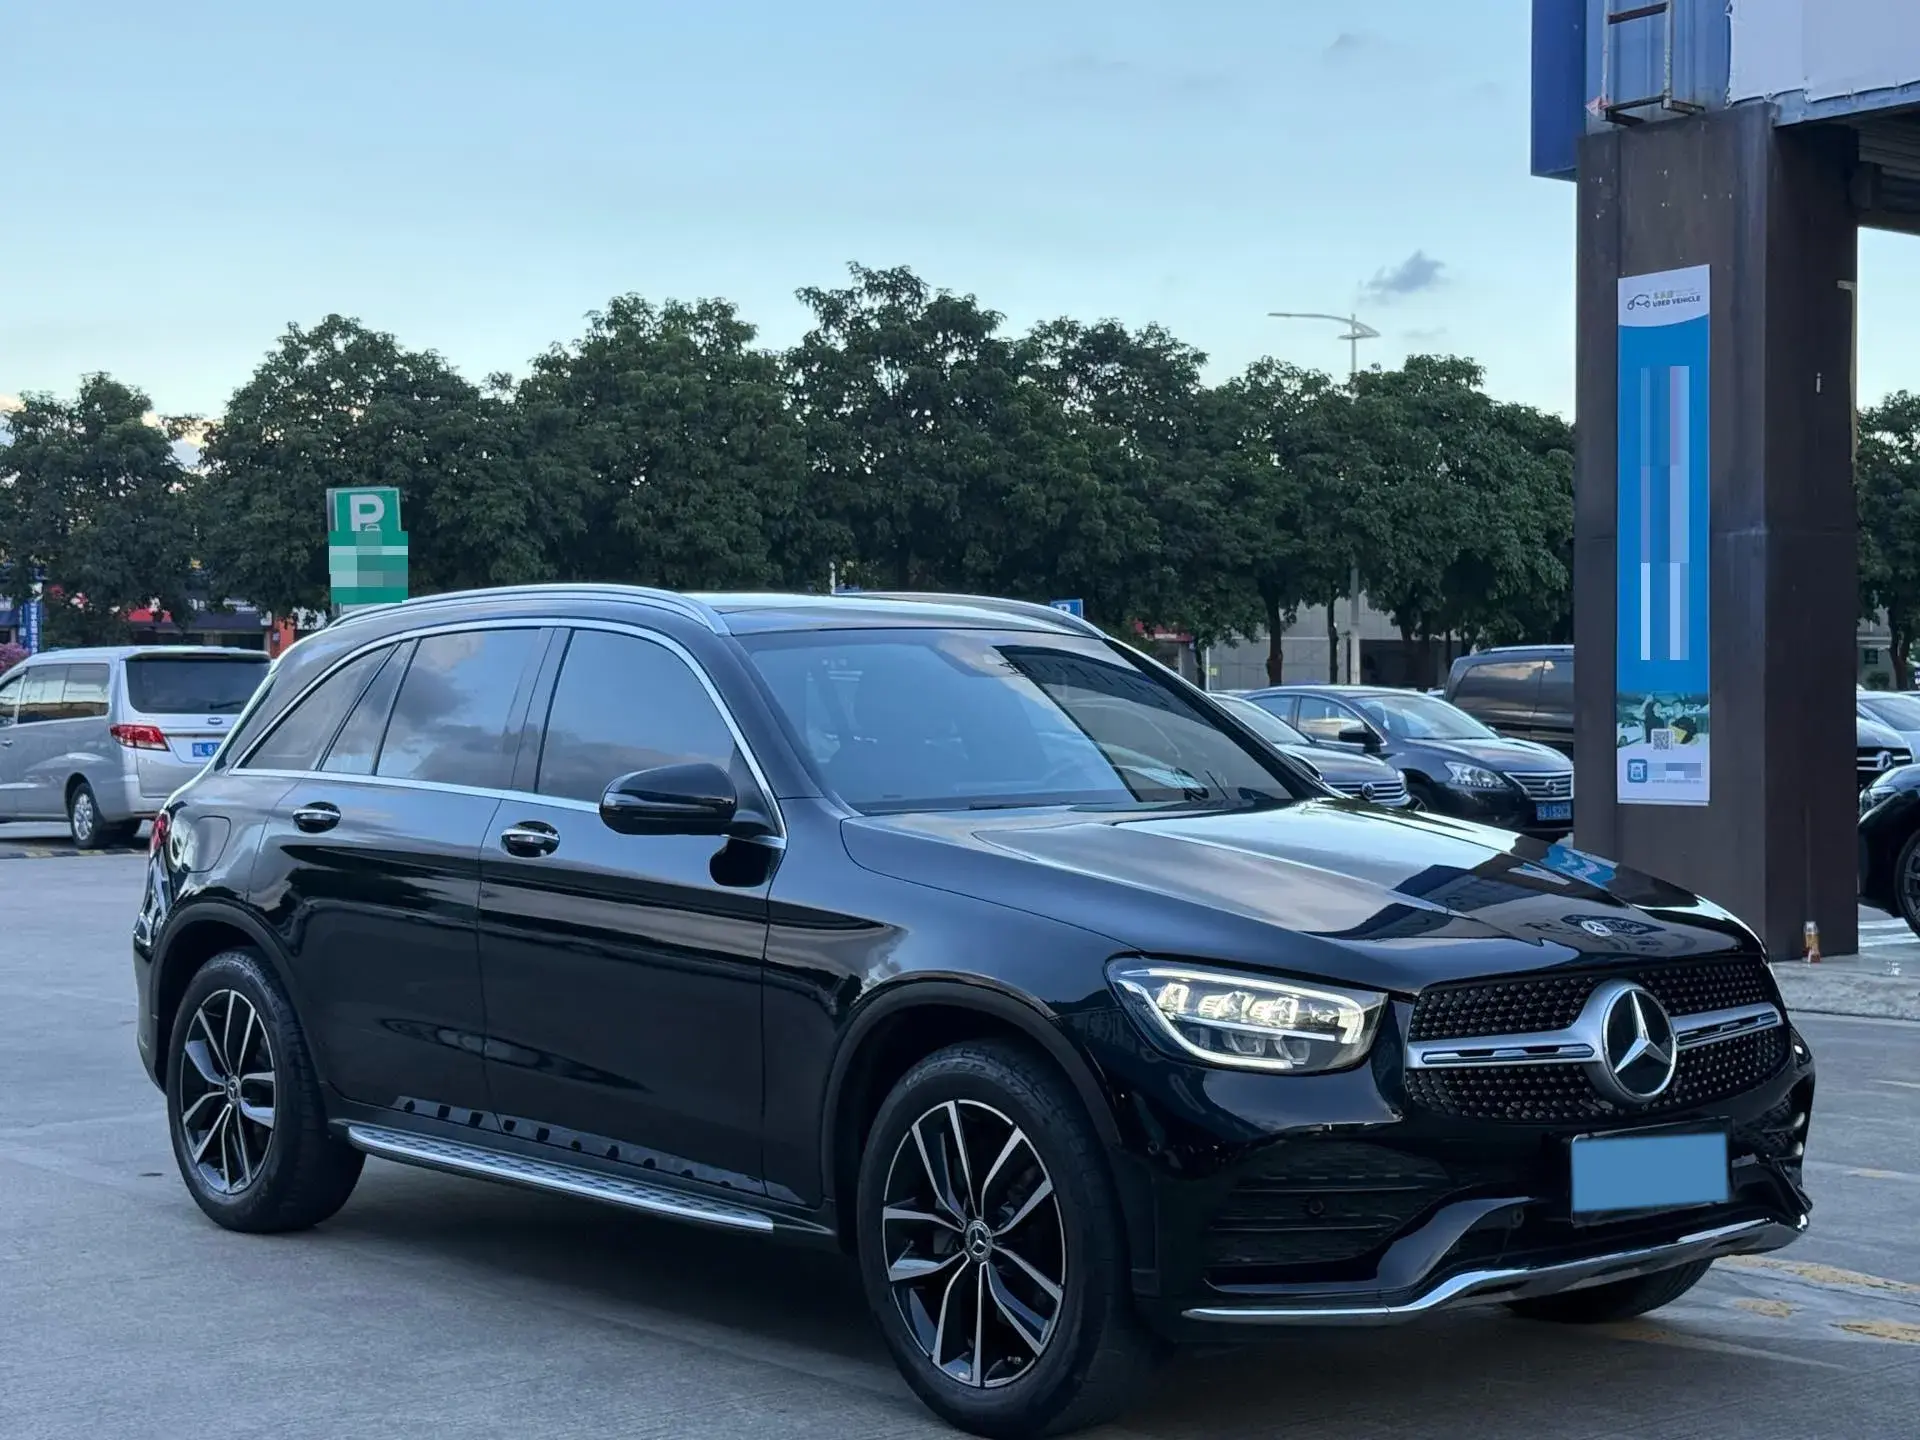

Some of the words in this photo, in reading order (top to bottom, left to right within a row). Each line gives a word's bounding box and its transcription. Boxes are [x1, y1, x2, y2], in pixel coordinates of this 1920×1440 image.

[1653, 299, 1670, 307] USED
[1672, 295, 1701, 304] VEHICLE
[350, 494, 384, 531] P
